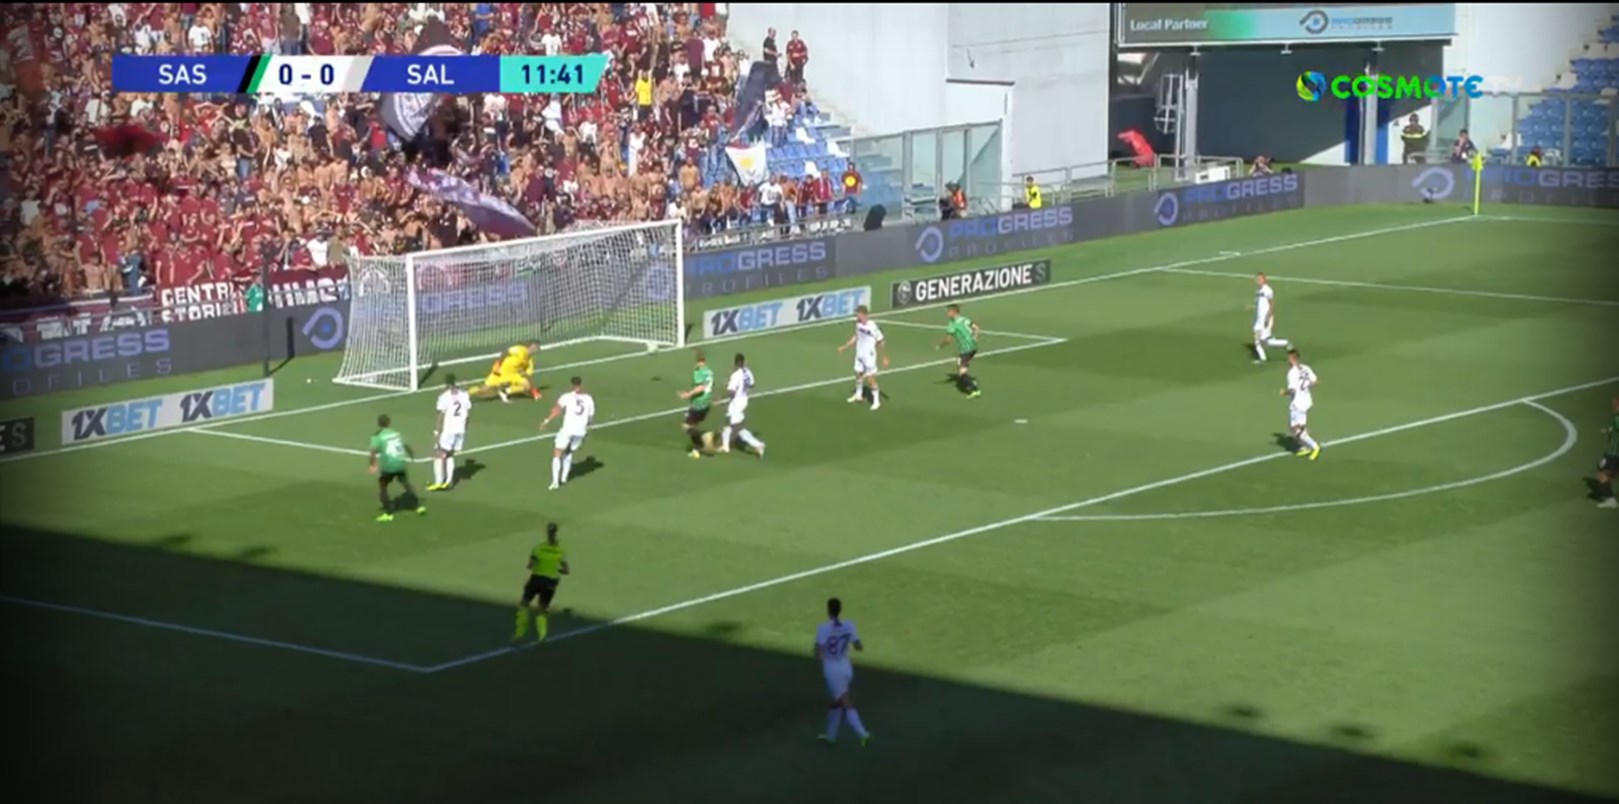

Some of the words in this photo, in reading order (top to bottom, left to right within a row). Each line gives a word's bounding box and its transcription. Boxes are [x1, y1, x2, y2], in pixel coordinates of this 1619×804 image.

[1130, 18, 1162, 32] Local
[1164, 18, 1208, 31] Partner
[1184, 172, 1299, 204] PROGRESS
[949, 206, 1073, 238] PROGRESS
[915, 263, 1033, 302] GENERAZIONE
[711, 302, 783, 337] 1XBET
[796, 289, 866, 322] 1XBET
[179, 382, 267, 423] 1XBET
[453, 401, 462, 417] 2
[575, 399, 585, 416] 5
[71, 399, 164, 441] 1XBET
[827, 633, 852, 656] 87
